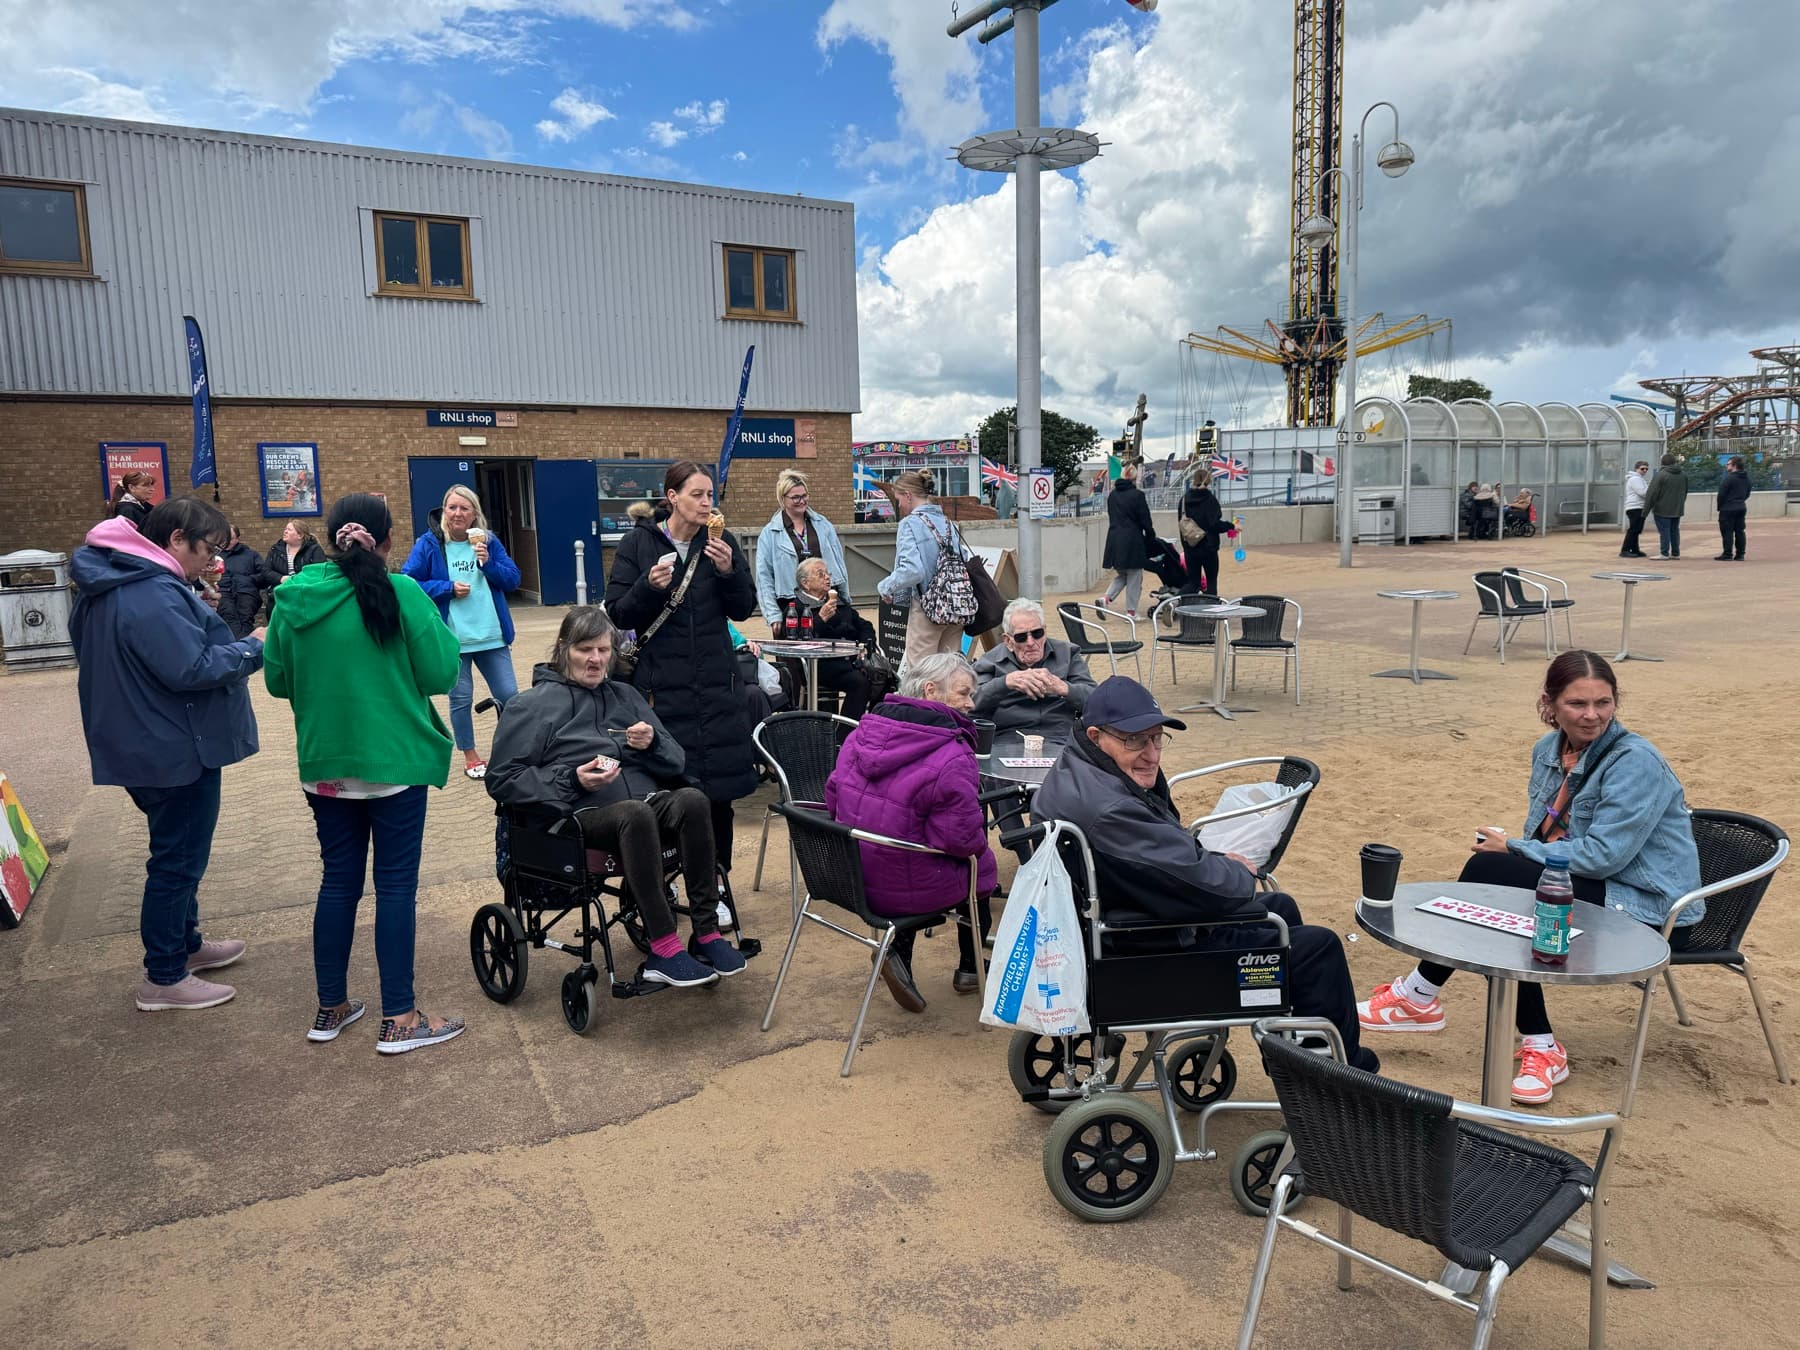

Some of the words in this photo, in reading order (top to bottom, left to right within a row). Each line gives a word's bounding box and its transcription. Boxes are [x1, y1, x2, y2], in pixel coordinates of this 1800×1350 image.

[440, 412, 465, 422] RNLI
[467, 413, 492, 425] shop
[741, 432, 766, 443] RNLI
[768, 432, 793, 446] shop
[883, 620, 907, 629] cappuccin
[884, 632, 906, 641] american
[1450, 901, 1491, 913] ONLY
[1432, 902, 1518, 926] CREAM
[1494, 911, 1532, 923] TING
[996, 962, 1017, 1015] MANSFIELD
[1013, 911, 1033, 958] DELIVERY
[1237, 953, 1281, 966] drive
[1011, 945, 1029, 992] CHEMIST
